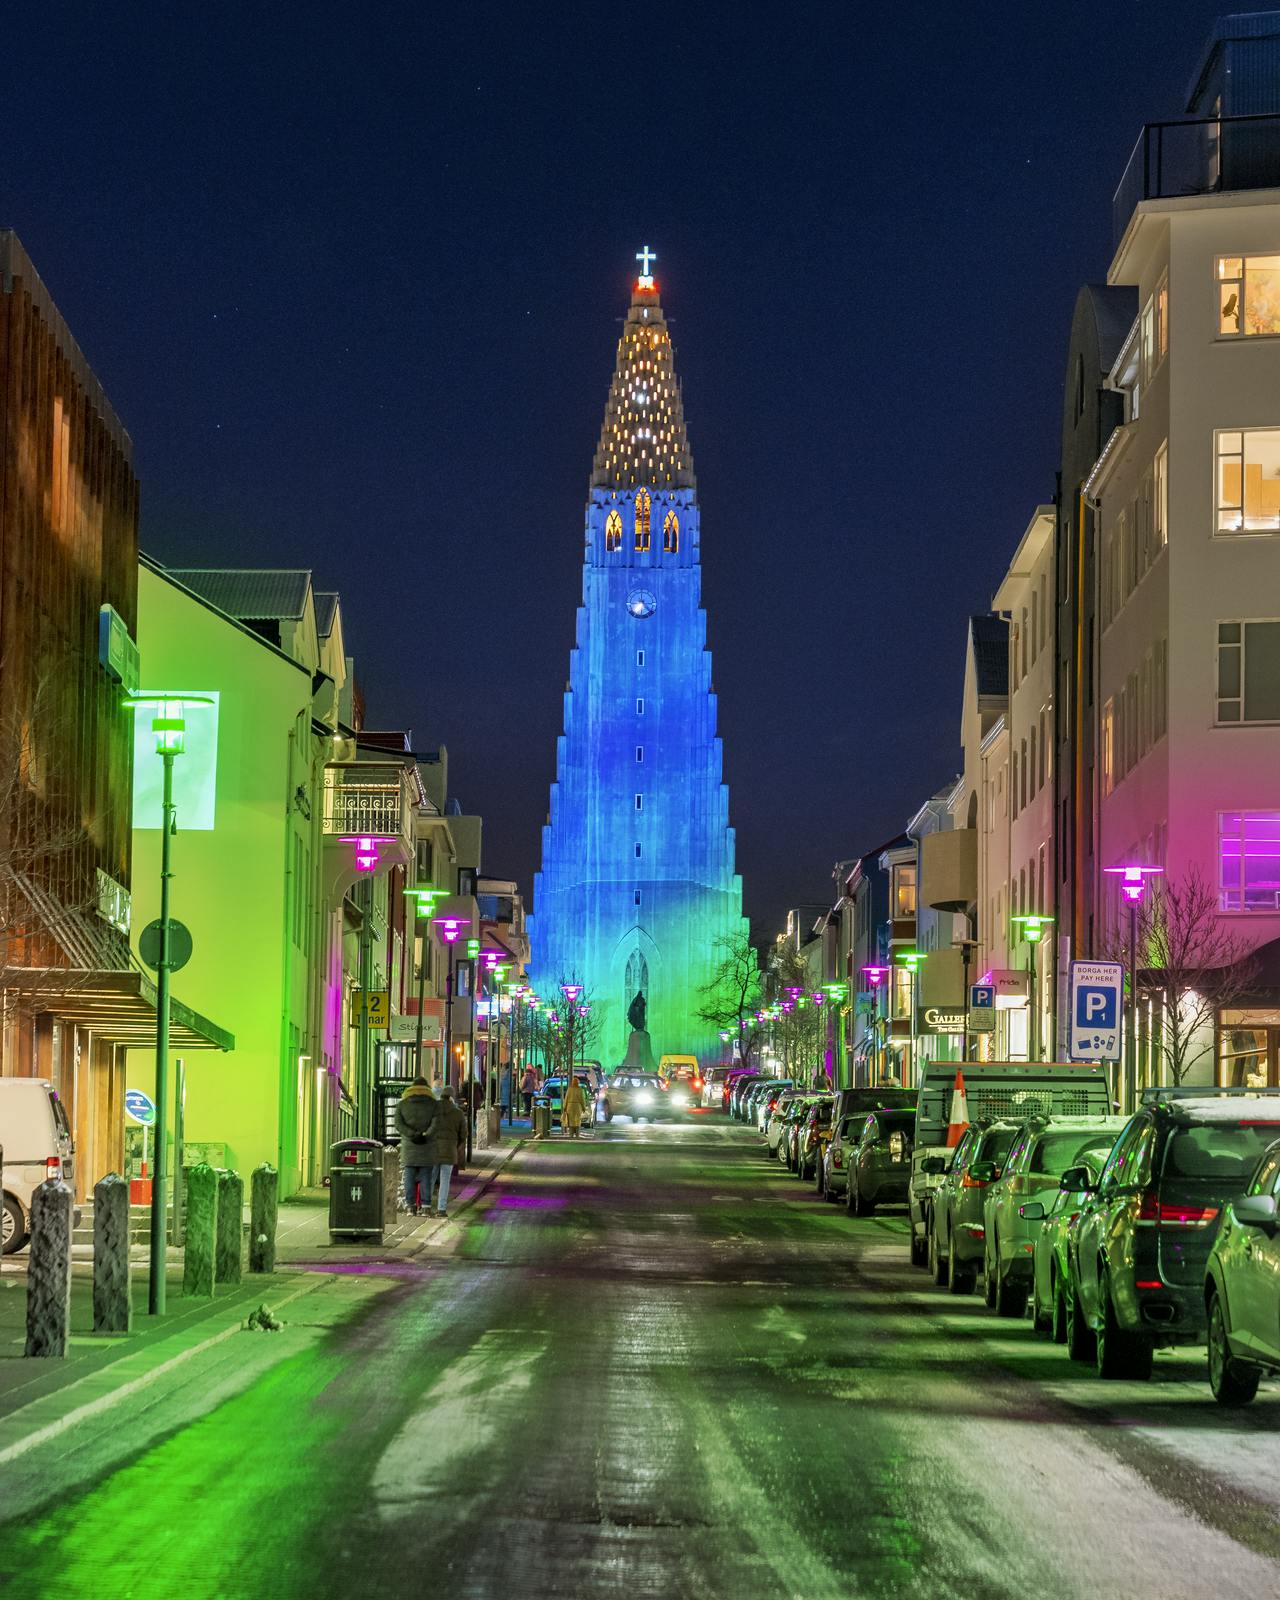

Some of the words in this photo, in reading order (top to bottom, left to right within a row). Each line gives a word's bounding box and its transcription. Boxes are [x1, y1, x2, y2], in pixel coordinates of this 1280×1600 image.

[370, 996, 380, 1012] 2
[977, 990, 988, 1004] P
[1086, 992, 1107, 1020] P
[356, 1014, 385, 1024] Tnar
